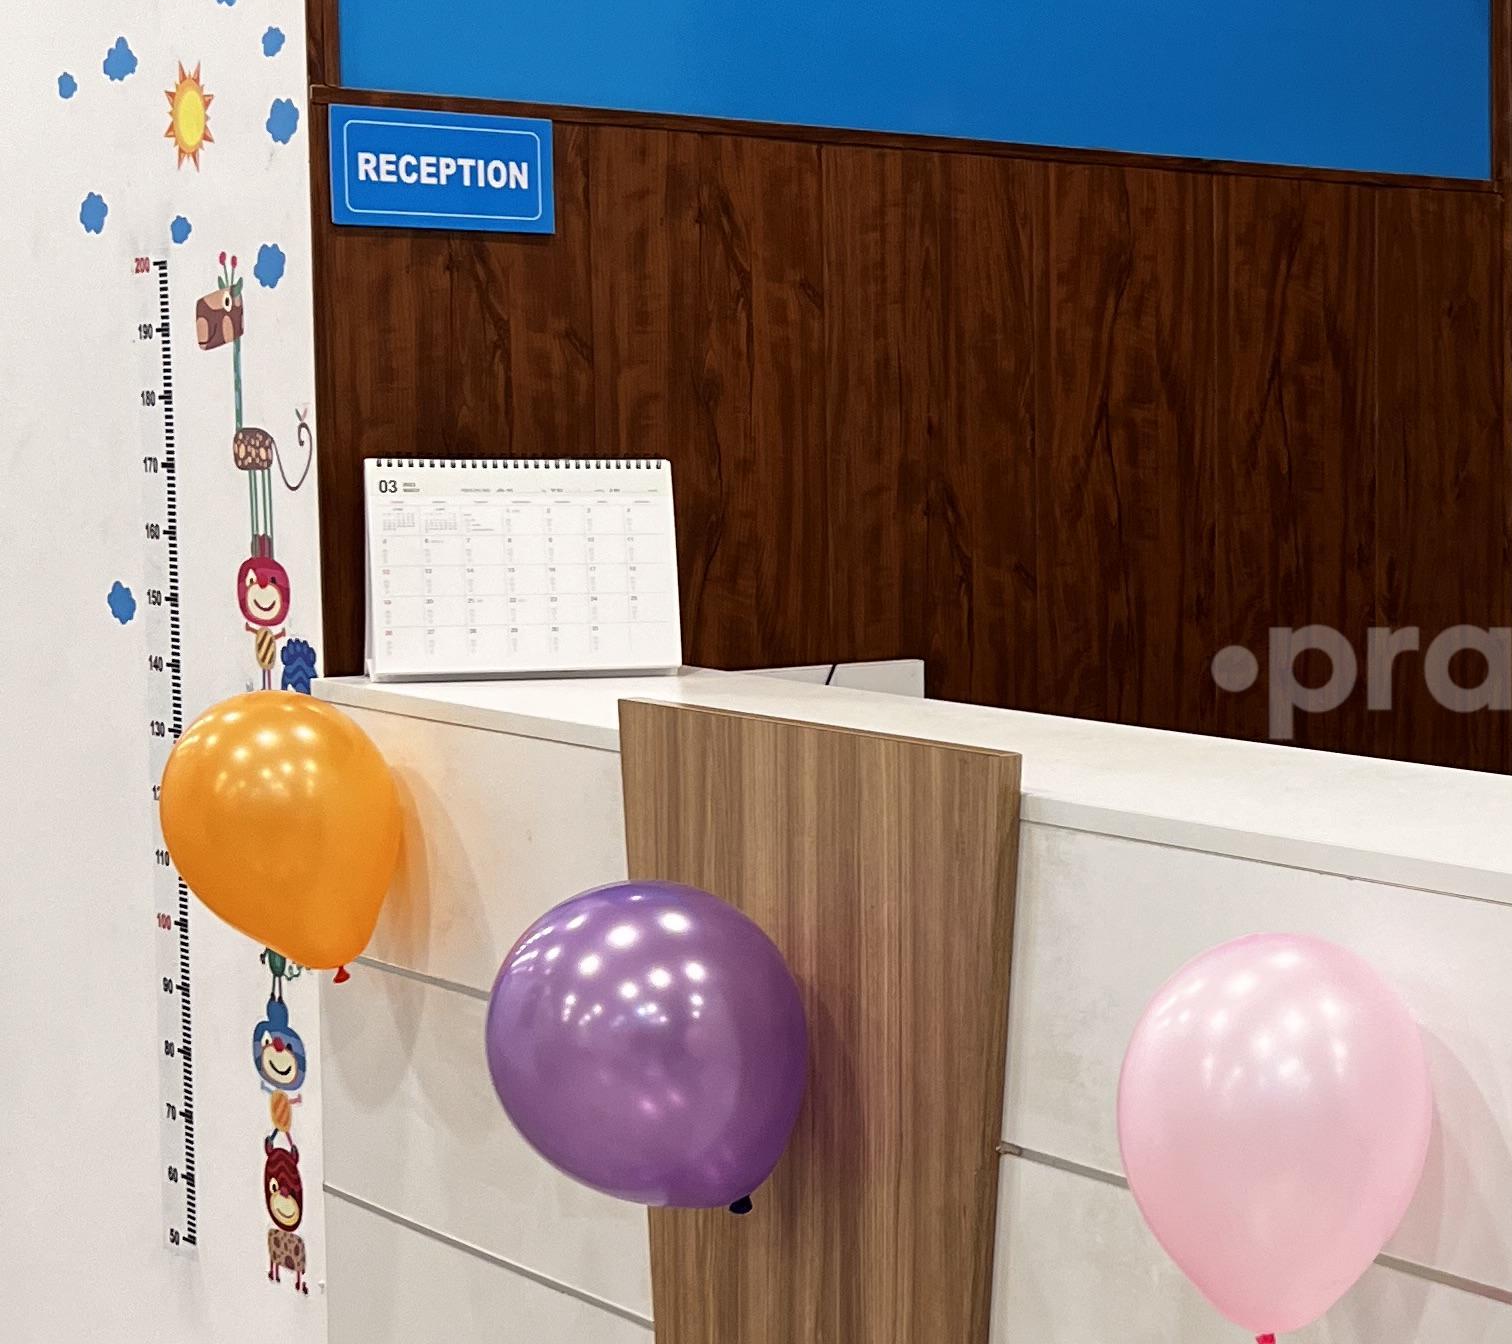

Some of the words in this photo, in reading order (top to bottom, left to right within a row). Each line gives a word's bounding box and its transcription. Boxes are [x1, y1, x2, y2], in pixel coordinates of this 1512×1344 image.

[357, 151, 529, 190] RECEPTION
[134, 257, 150, 274] 200
[137, 323, 153, 340] 190
[140, 390, 156, 407] 180
[142, 456, 158, 474] 170
[378, 479, 398, 494] 03
[144, 522, 160, 540] 160
[146, 588, 162, 607] 150
[148, 654, 164, 673] 140
[149, 719, 166, 738] 130
[155, 848, 170, 867] 110
[156, 913, 172, 931] 100
[162, 977, 173, 994] 90
[164, 1040, 175, 1058] 80
[165, 1102, 177, 1121] 70
[167, 1166, 179, 1184] 60
[169, 1227, 180, 1246] 50
